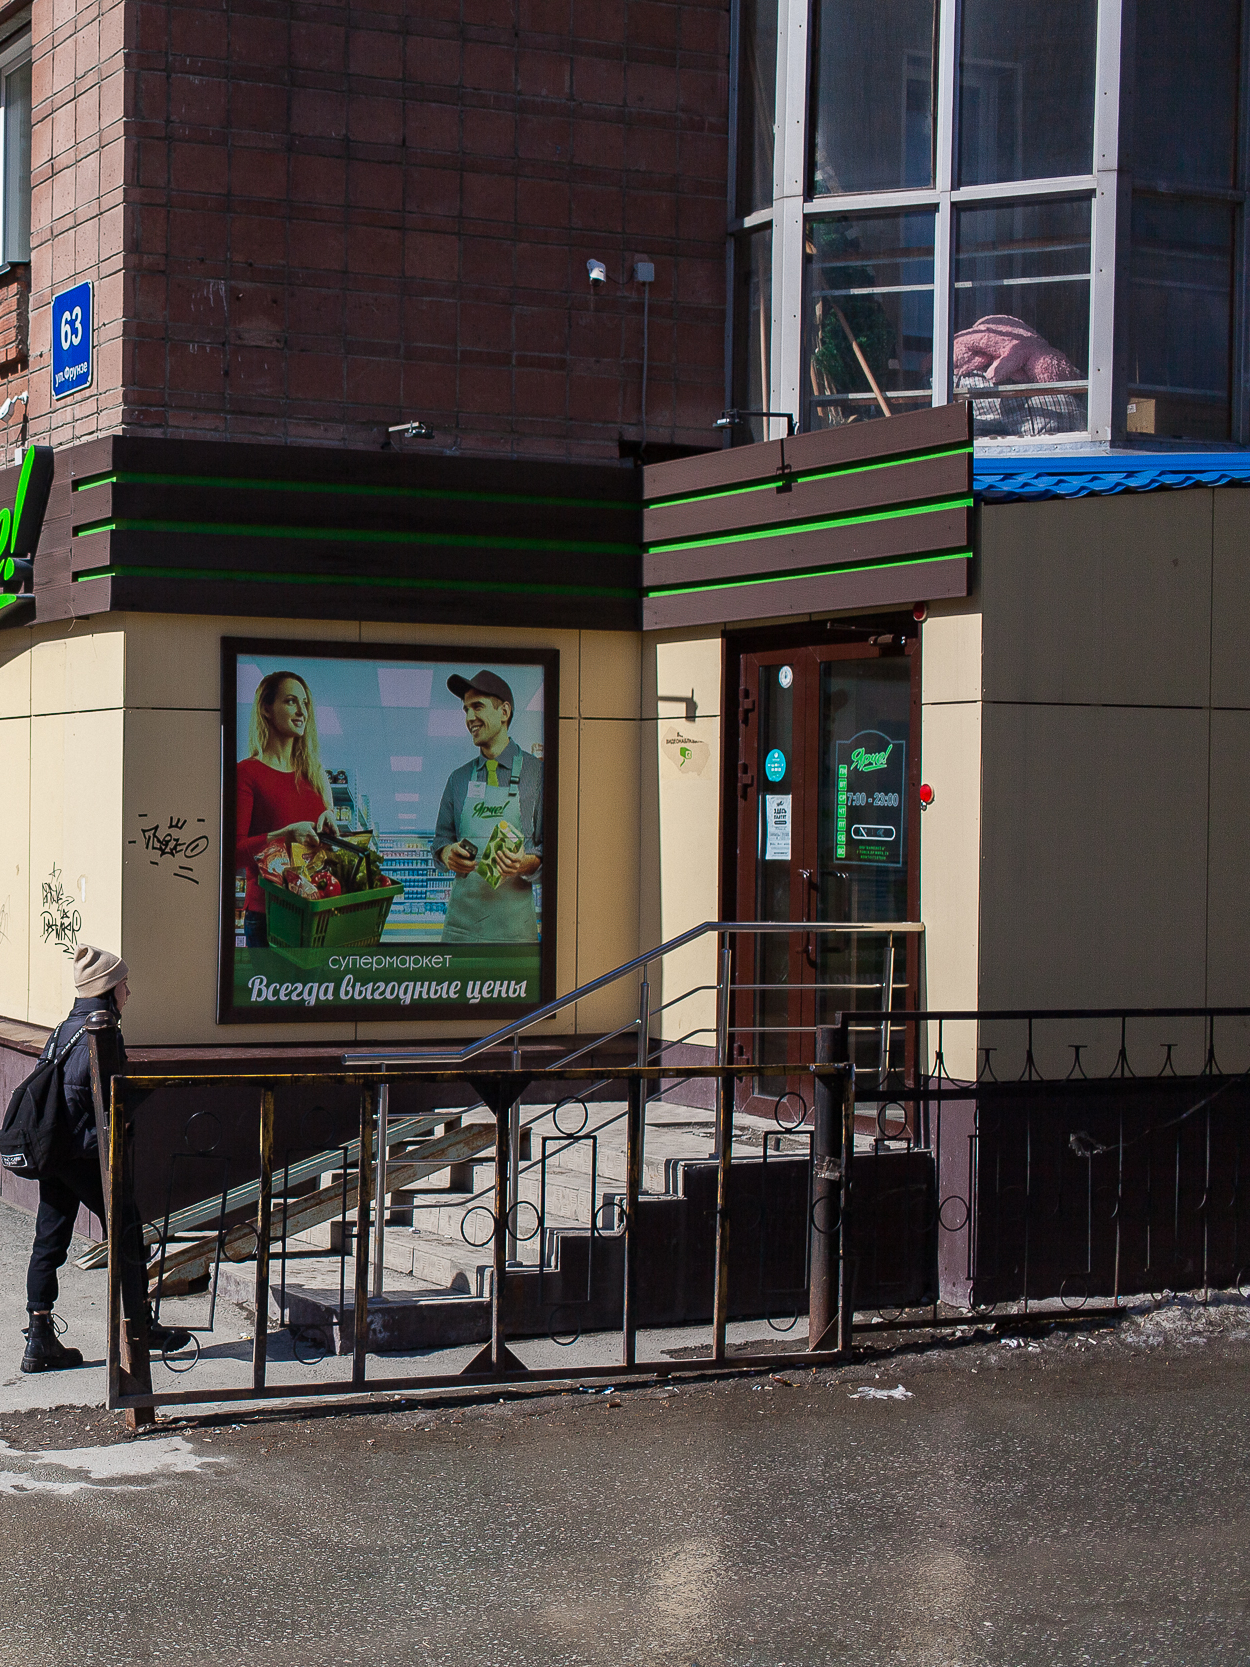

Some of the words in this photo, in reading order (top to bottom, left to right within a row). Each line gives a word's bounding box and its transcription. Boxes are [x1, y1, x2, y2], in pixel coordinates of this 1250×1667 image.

[61, 306, 83, 351] 63
[850, 743, 893, 772] Ярче!
[472, 800, 511, 819] Ярче!
[847, 792, 867, 806] 7:00
[873, 792, 899, 807] 23:00
[328, 955, 452, 972] супермаркет
[248, 974, 335, 1007] Всегда
[340, 973, 462, 1006] выгодные
[466, 979, 528, 1005] цены
